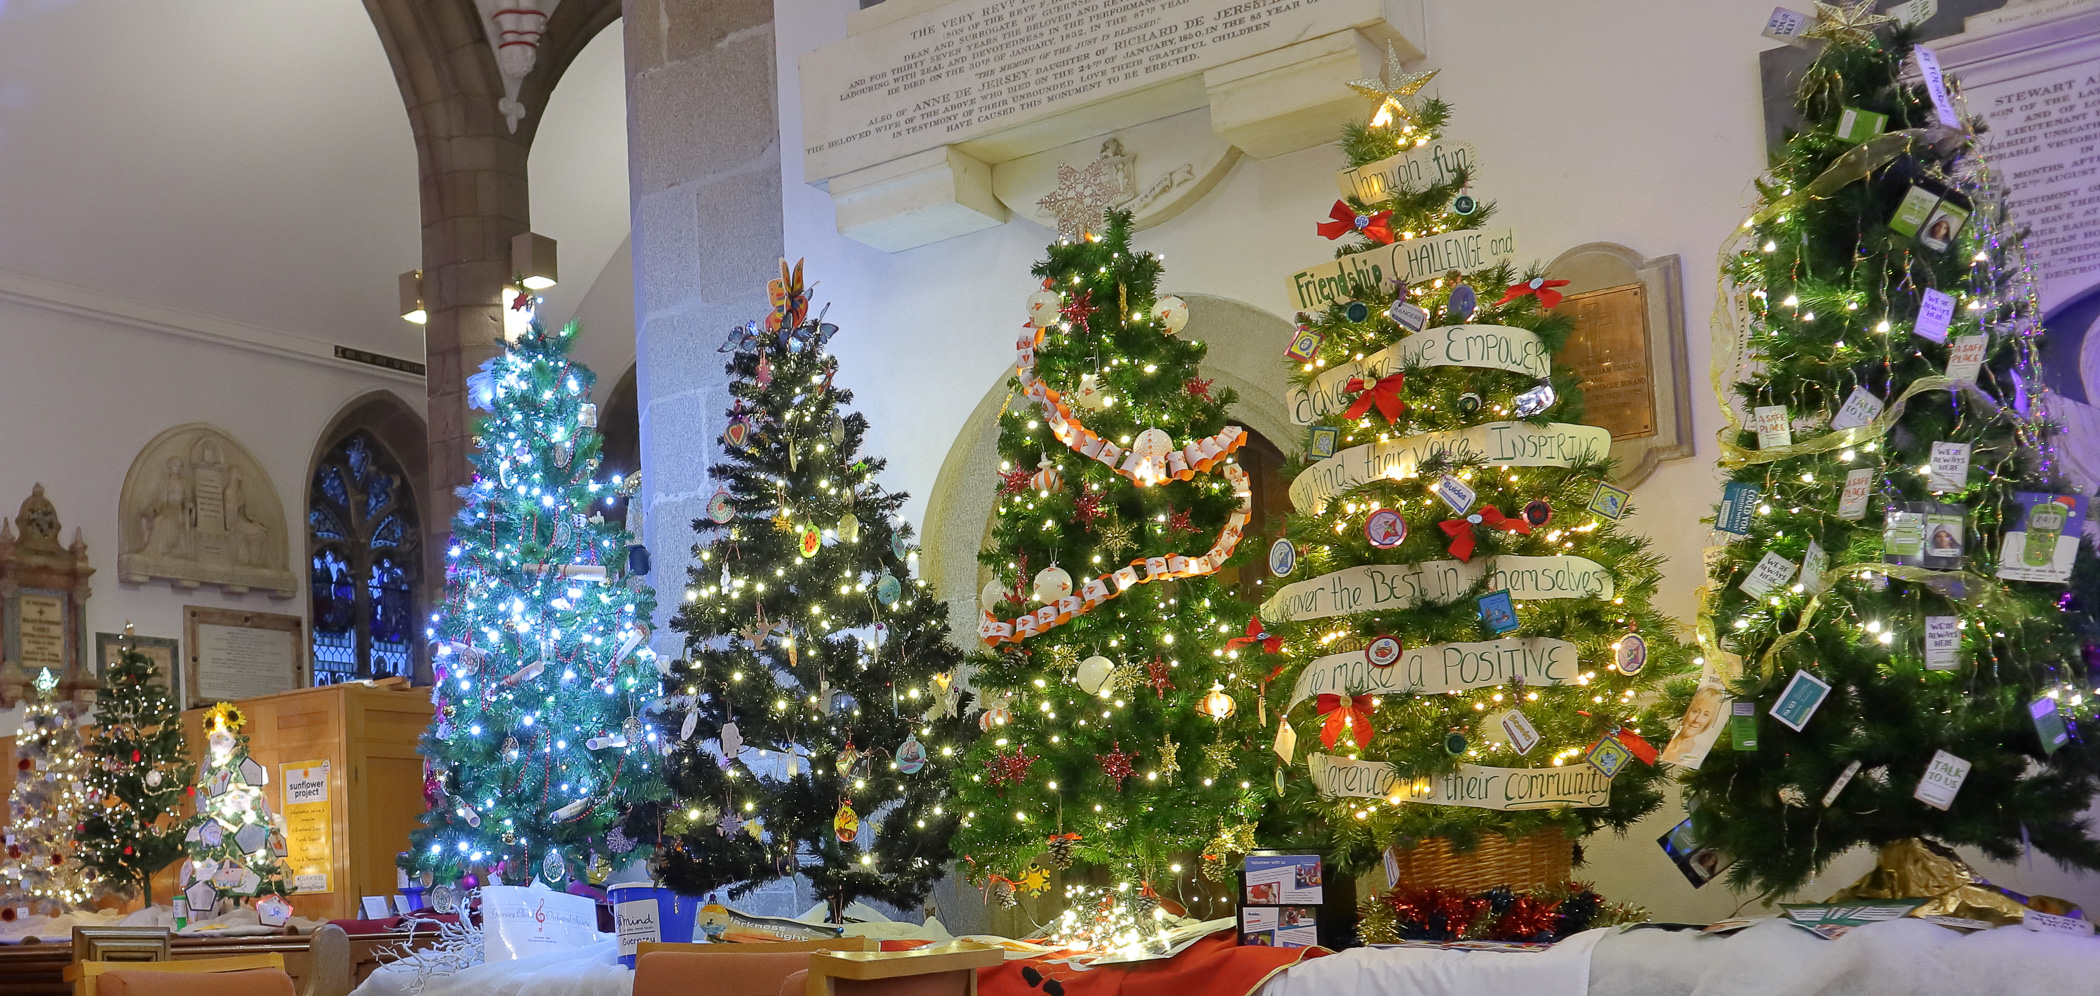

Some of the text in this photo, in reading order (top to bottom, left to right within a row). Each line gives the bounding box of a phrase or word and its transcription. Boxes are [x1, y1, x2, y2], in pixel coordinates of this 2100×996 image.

[910, 11, 975, 40] THE VERY
[1770, 17, 1777, 28] BE
[1775, 14, 1789, 35] YOUR
[1784, 18, 1796, 36] SELF
[849, 5, 1098, 89] AND FOR THIRTY SEVEN YEARS THE BELOVED AND
[904, 14, 1037, 62] DEAN AND SURROGATE OF
[840, 19, 1084, 101] LABOURING WITH ZEAL AND DEVOTEDNESS IN THE
[807, 145, 824, 155] THE
[829, 130, 871, 149] BELOVED
[875, 121, 901, 134] WIFE
[905, 116, 917, 125] OF
[920, 110, 939, 120] THE
[944, 98, 976, 113] ABOVE
[981, 91, 1002, 101] WHO
[1008, 81, 1030, 94] DIED
[1035, 76, 1048, 84] ON
[1053, 68, 1074, 80] THE
[1105, 55, 1117, 64] OF
[1206, 25, 1218, 35] IN
[1222, 17, 1245, 29] THE
[1250, 12, 1261, 21] 85
[1266, 1, 1300, 16] YEAR
[869, 16, 1204, 126] ALSO OF ANNE DE DAUGHTER OF RICHARD DE
[893, 21, 1271, 138] IN TESTIMONY OF THEIR UNBOUNDED LOVE THEIR GRATEFUL CHILDREN
[947, 54, 1200, 132] HAVE CAUSED THIS MONUMENT TO BE ERECTED.
[1995, 81, 2076, 106] STEWART
[1990, 95, 2070, 118] SON OF THE
[2024, 104, 2076, 122] AND OF
[2006, 112, 2088, 136] LIEUTENANT
[1981, 136, 2037, 152] CARRIED
[1343, 155, 1422, 200] Through
[2014, 164, 2064, 179] MONTHS
[2046, 168, 2096, 184] AUGUST
[2027, 204, 2062, 216] MARK
[2042, 213, 2074, 224] HAVE
[1391, 234, 1484, 282] CHALLENGE
[1963, 344, 1983, 352] SAFE
[1952, 355, 1979, 363] PLACE
[1845, 405, 1856, 416] TO
[1851, 396, 1876, 415] TALK
[1766, 414, 1784, 422] SAFE
[1760, 424, 1785, 433] PLACE
[1852, 477, 1869, 485] SAFE
[1444, 481, 1467, 500] Guides
[1844, 488, 1866, 498] PLACE
[1739, 489, 1756, 532] COULD YOU
[1759, 564, 1787, 580] ALWAYS
[1331, 576, 1362, 608] the
[1372, 569, 1428, 604] BEST
[1437, 564, 1467, 598] in
[1928, 631, 1958, 639] ALWAYS
[1409, 655, 1423, 688] a
[1443, 642, 1569, 685] POSITIVE
[1934, 760, 1964, 778] TALK
[289, 781, 324, 790] sunflower
[1444, 772, 1500, 800] their
[1504, 767, 1609, 806] community
[1928, 771, 1958, 789] TO US
[294, 789, 319, 799] project
[623, 914, 654, 926] mind
[775, 932, 808, 941] light
